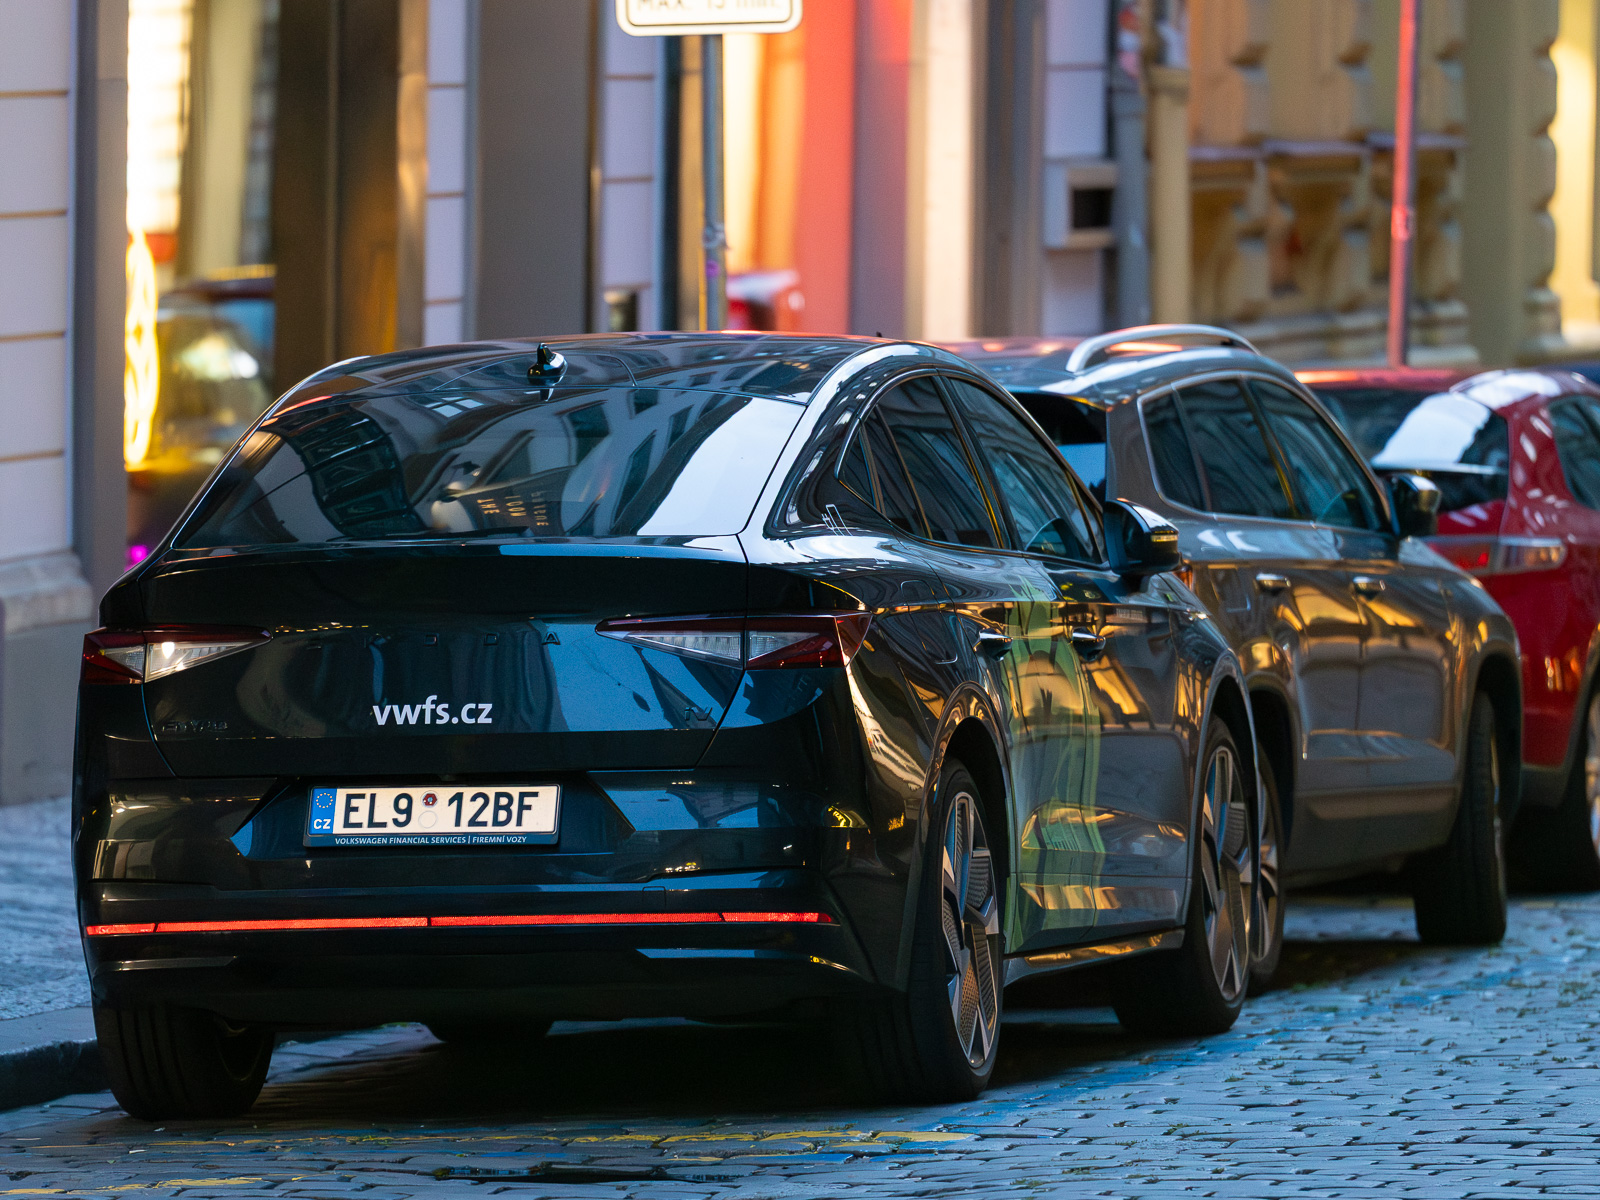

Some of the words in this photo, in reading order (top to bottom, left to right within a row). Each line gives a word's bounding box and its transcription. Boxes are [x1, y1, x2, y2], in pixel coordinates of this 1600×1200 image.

[372, 694, 493, 726] vwfs.cz
[447, 791, 540, 828] 12BF
[313, 818, 332, 830] CZ
[335, 837, 388, 845] VOLKSWAGEN
[389, 836, 430, 844] FINANCIAL
[430, 836, 466, 844] SERVICES
[472, 834, 506, 844] FIREMNÍ
[506, 835, 528, 843] VOZY
